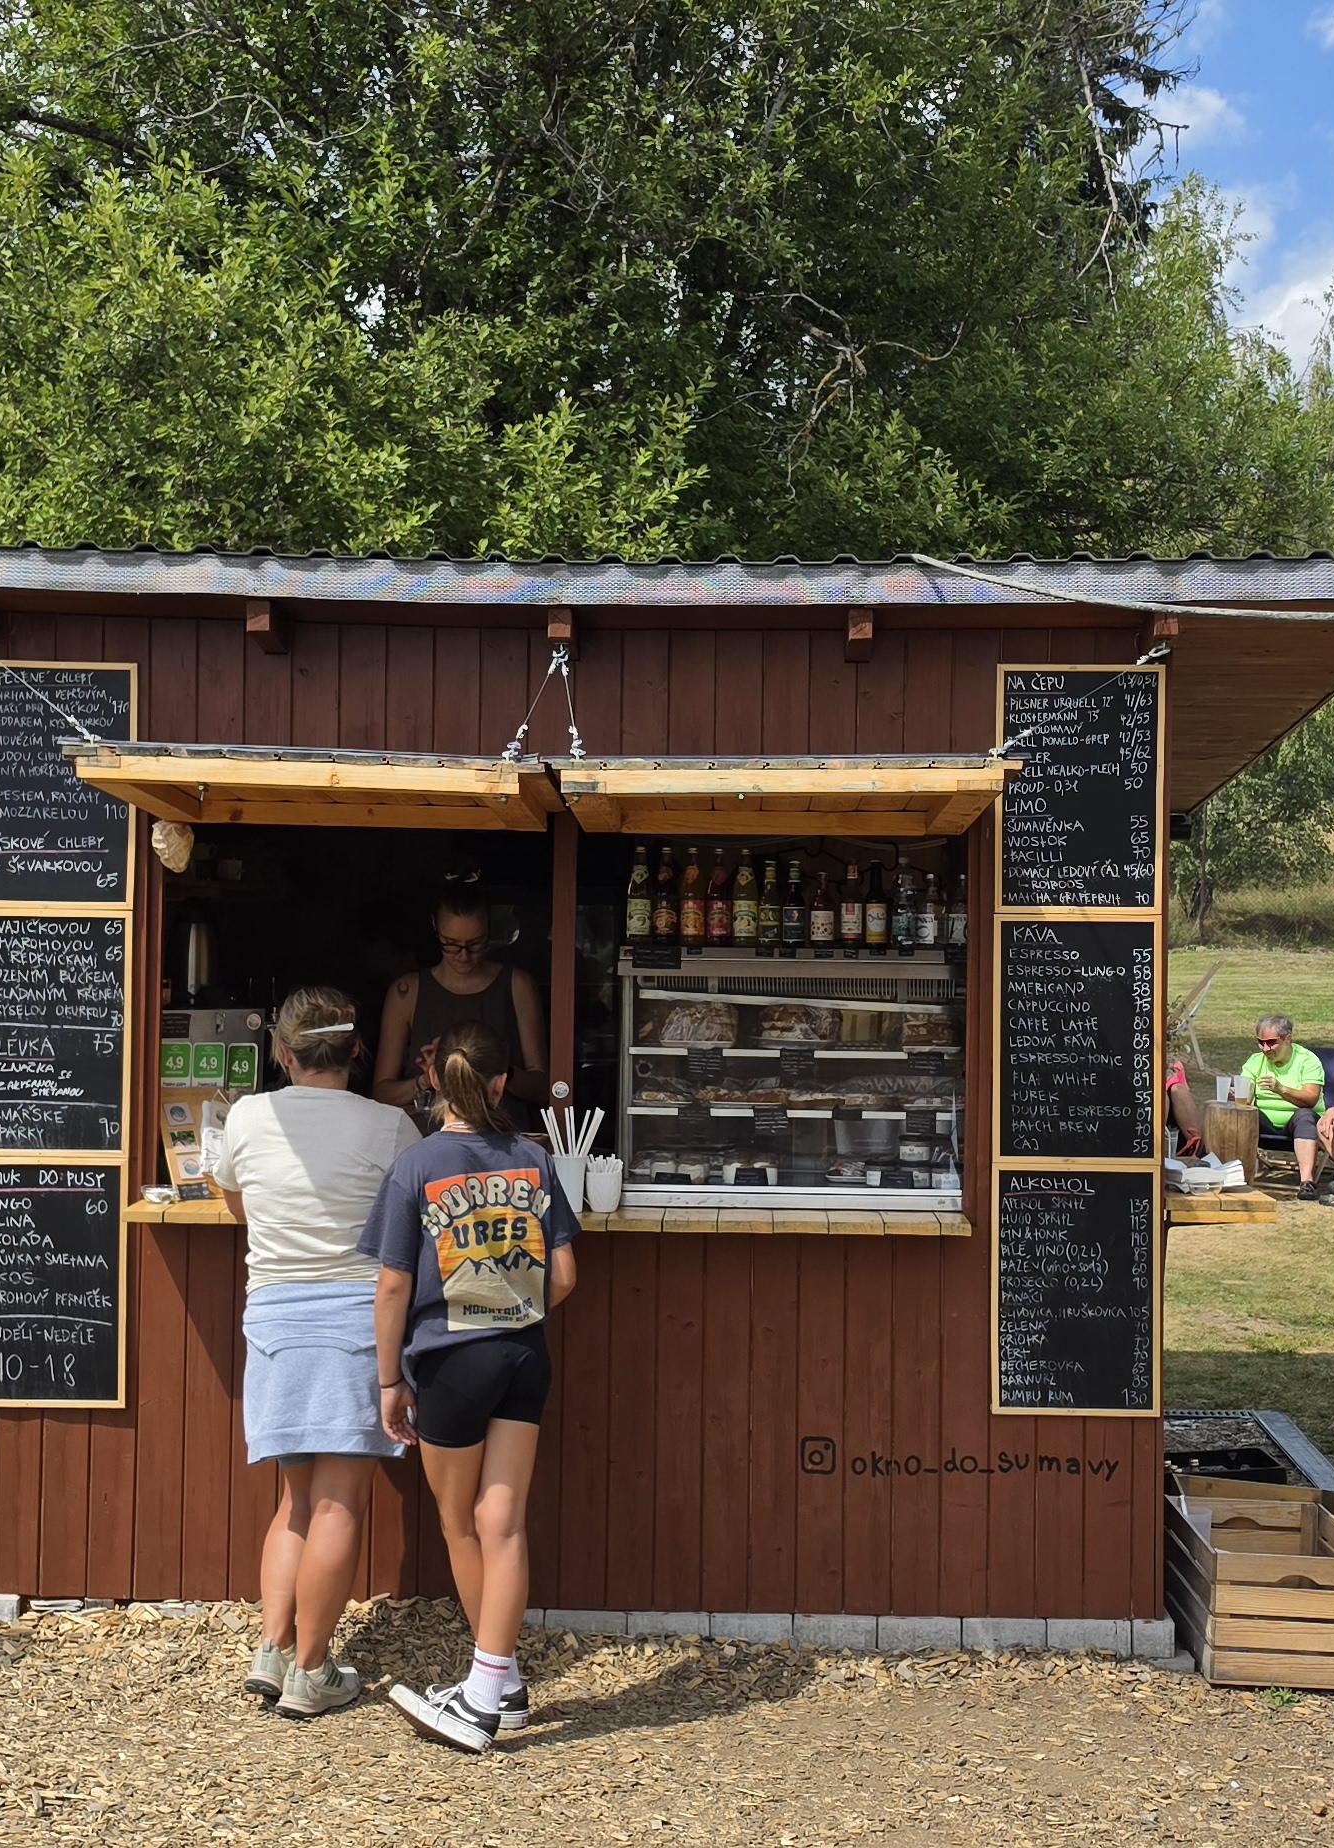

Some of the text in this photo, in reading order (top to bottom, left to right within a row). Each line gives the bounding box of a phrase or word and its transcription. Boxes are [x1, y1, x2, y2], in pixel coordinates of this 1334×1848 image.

[55, 672, 94, 684] CHLEBY
[1007, 673, 1064, 690] NA ČEPU
[1010, 697, 1048, 710] PILSNER
[1053, 696, 1097, 708] URQUELL
[1131, 762, 1148, 775] 50
[1125, 777, 1143, 790] 50
[104, 804, 127, 820] 110
[1005, 798, 1047, 814] LIMO
[1130, 815, 1148, 829] 55
[58, 836, 104, 849] CHLEBY
[1130, 832, 1149, 844] 65
[1133, 846, 1150, 859] 70
[7, 856, 102, 874] ŠKVARKOVOU
[97, 873, 118, 888] 65
[1135, 892, 1149, 904] 70
[104, 921, 122, 935] 65
[1014, 924, 1062, 944] KÁVA
[106, 946, 123, 961] 65
[1010, 948, 1152, 962] ESPRESSO 55
[1133, 965, 1151, 980] 58
[1008, 982, 1150, 996] AMERICANO 58
[1008, 998, 1151, 1013] CAPPUCCINO 75
[56, 1005, 108, 1019] OKURKOU
[111, 1011, 124, 1028] 70
[1133, 1017, 1149, 1030] 80
[94, 1034, 115, 1054] 75
[1010, 1033, 1056, 1048] LEDOVÁ
[1133, 1033, 1150, 1049] 85
[166, 1056, 184, 1069] 4,9
[199, 1056, 217, 1069] 4,9
[232, 1060, 249, 1074] 4,9
[1134, 1054, 1150, 1069] 85
[58, 1070, 72, 1080] SE
[1133, 1072, 1149, 1087] 89
[1135, 1091, 1152, 1104] 55
[1011, 1104, 1060, 1117] DOUBLE
[1069, 1105, 1131, 1117] ESPRESSO
[99, 1117, 119, 1138] 90
[1060, 1121, 1099, 1133] BREW
[1136, 1124, 1150, 1136] 70
[1133, 1139, 1149, 1152] 55
[39, 1170, 58, 1185] DO
[67, 1171, 105, 1187] PUSY
[1010, 1177, 1095, 1193] ALKOHOL
[86, 1199, 108, 1215] 60
[1130, 1199, 1149, 1214] 135
[1130, 1214, 1147, 1230] 115
[1036, 1242, 1064, 1256] VÍNO
[44, 1253, 109, 1269] SMETANA
[1132, 1263, 1147, 1275] 60
[1130, 1306, 1149, 1319] 105
[1000, 1320, 1049, 1332] ZELENÁ
[1002, 1361, 1145, 1374] BECHEROVKA 65
[1132, 1374, 1149, 1388] 85
[1002, 1388, 1147, 1406] BUMBU RUM 130
